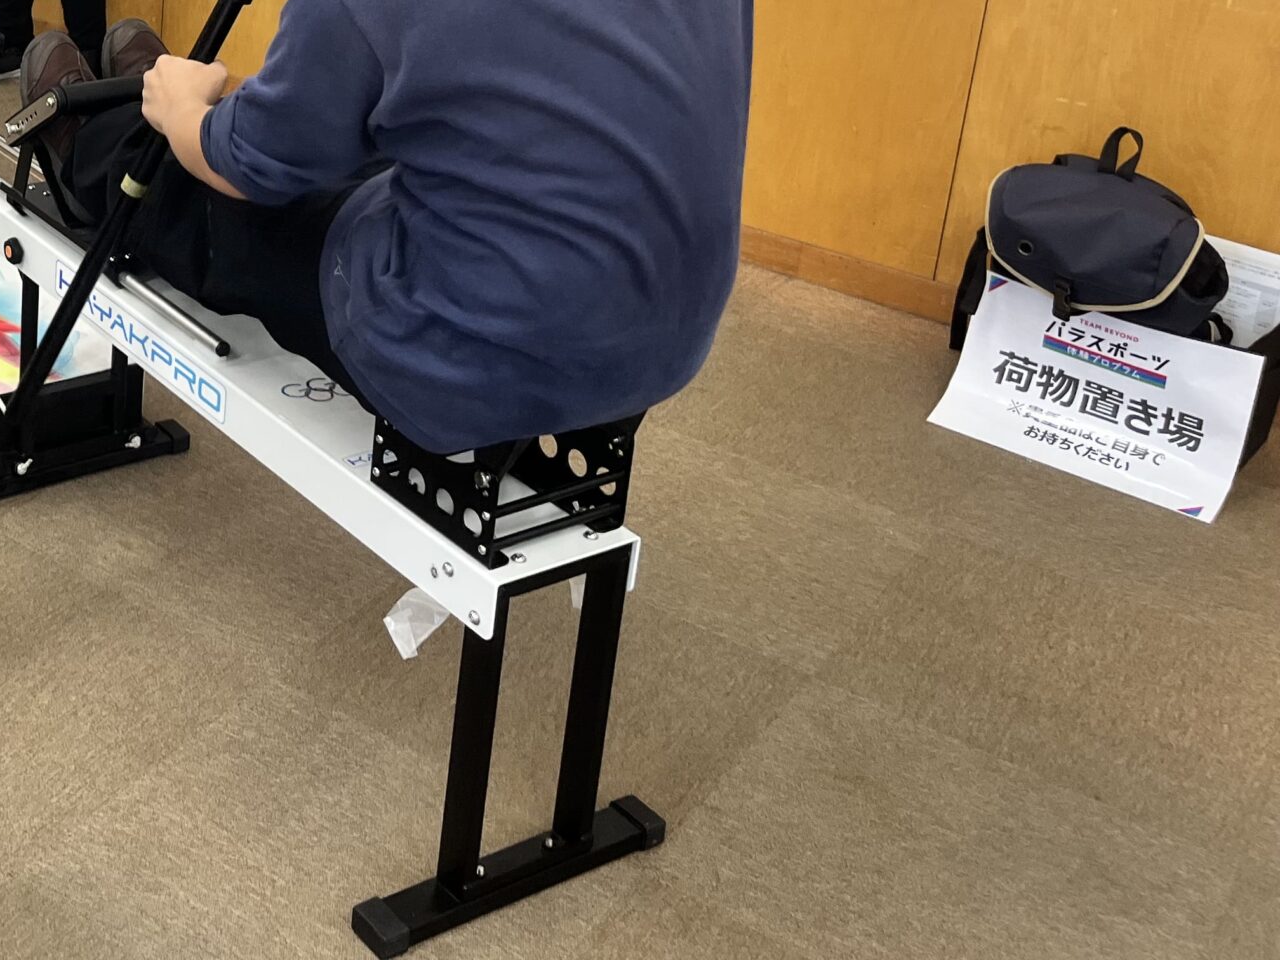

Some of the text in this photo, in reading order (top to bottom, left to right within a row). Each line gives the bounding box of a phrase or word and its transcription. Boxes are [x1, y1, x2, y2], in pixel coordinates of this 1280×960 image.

[1045, 320, 1171, 372] パラスポーツ
[1079, 318, 1140, 344] TEAM BEYOND
[992, 348, 1205, 453] 荷物置き場
[1023, 424, 1131, 472] お持ちください
